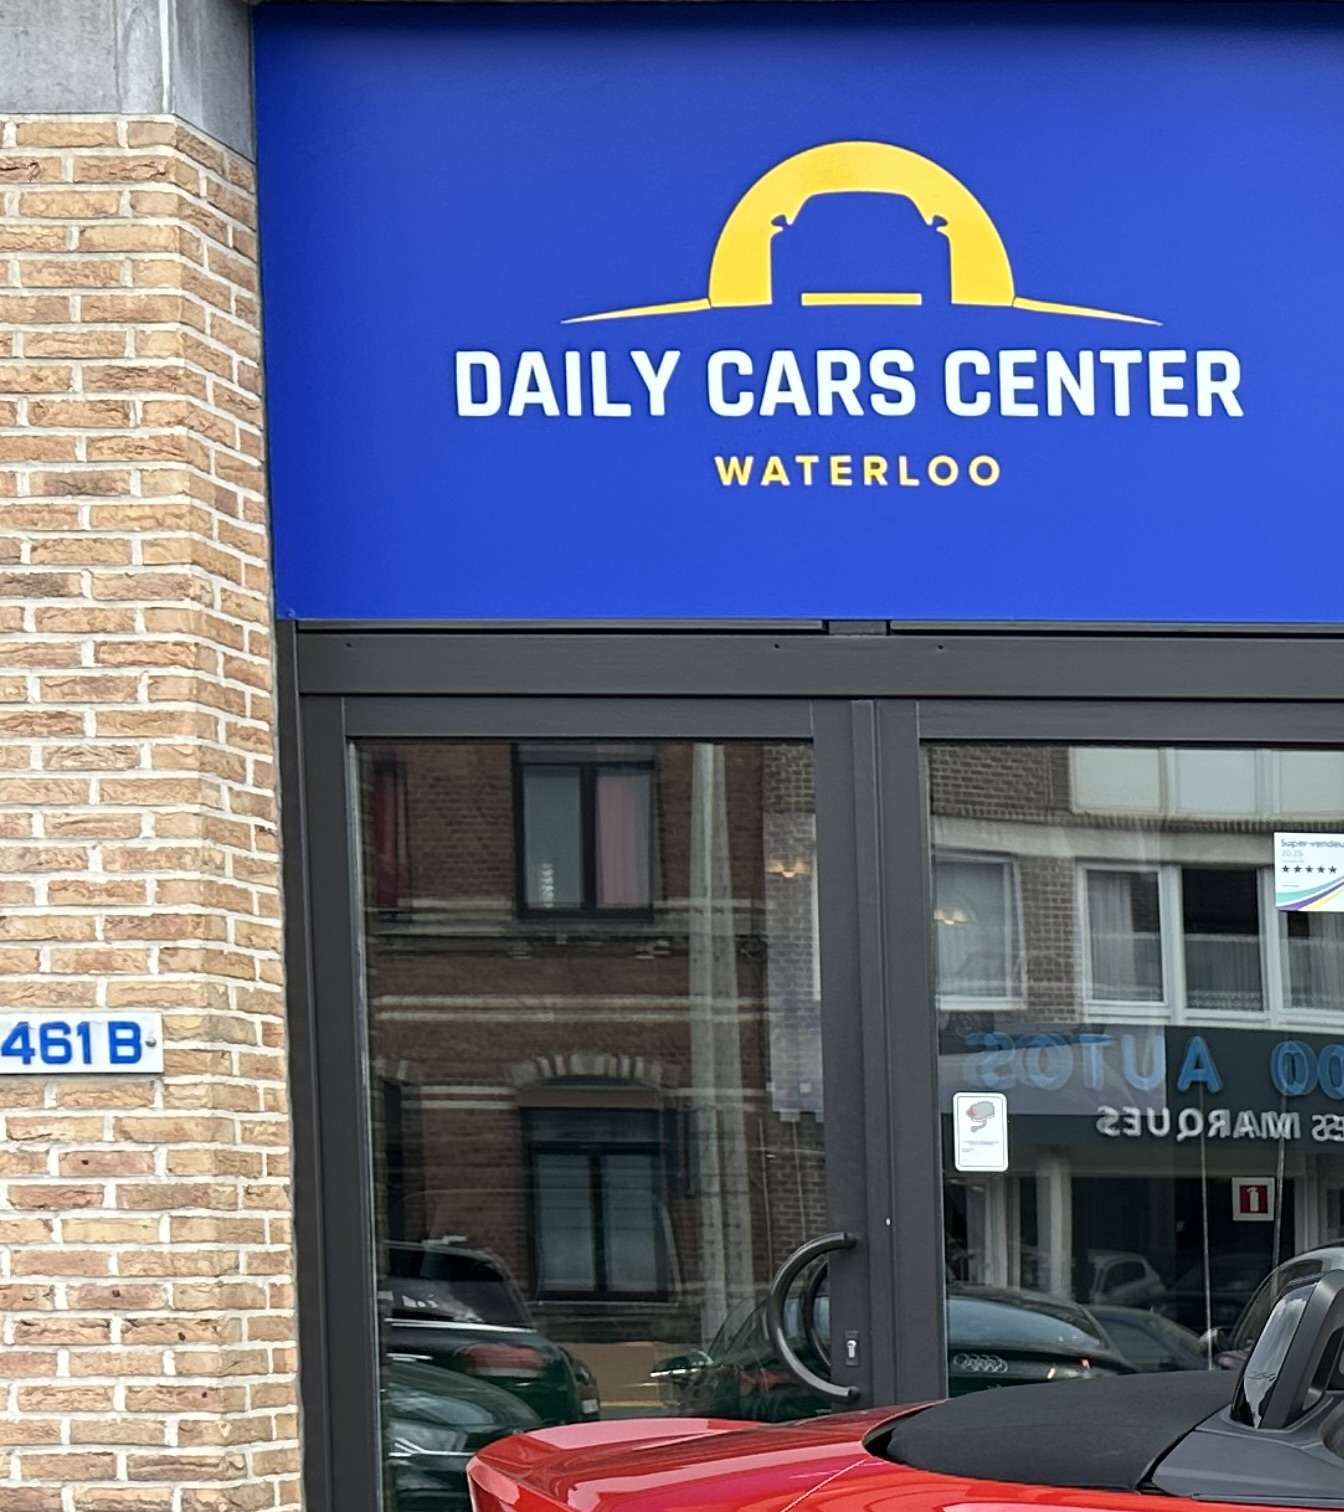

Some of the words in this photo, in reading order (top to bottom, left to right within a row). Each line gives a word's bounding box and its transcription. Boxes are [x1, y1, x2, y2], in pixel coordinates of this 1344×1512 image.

[454, 349, 681, 418] DAILY
[707, 349, 917, 418] CARS
[944, 349, 1244, 418] CENTER
[713, 455, 1001, 487] WATERLOO
[0, 1020, 92, 1066] 461
[107, 1020, 143, 1065] B
